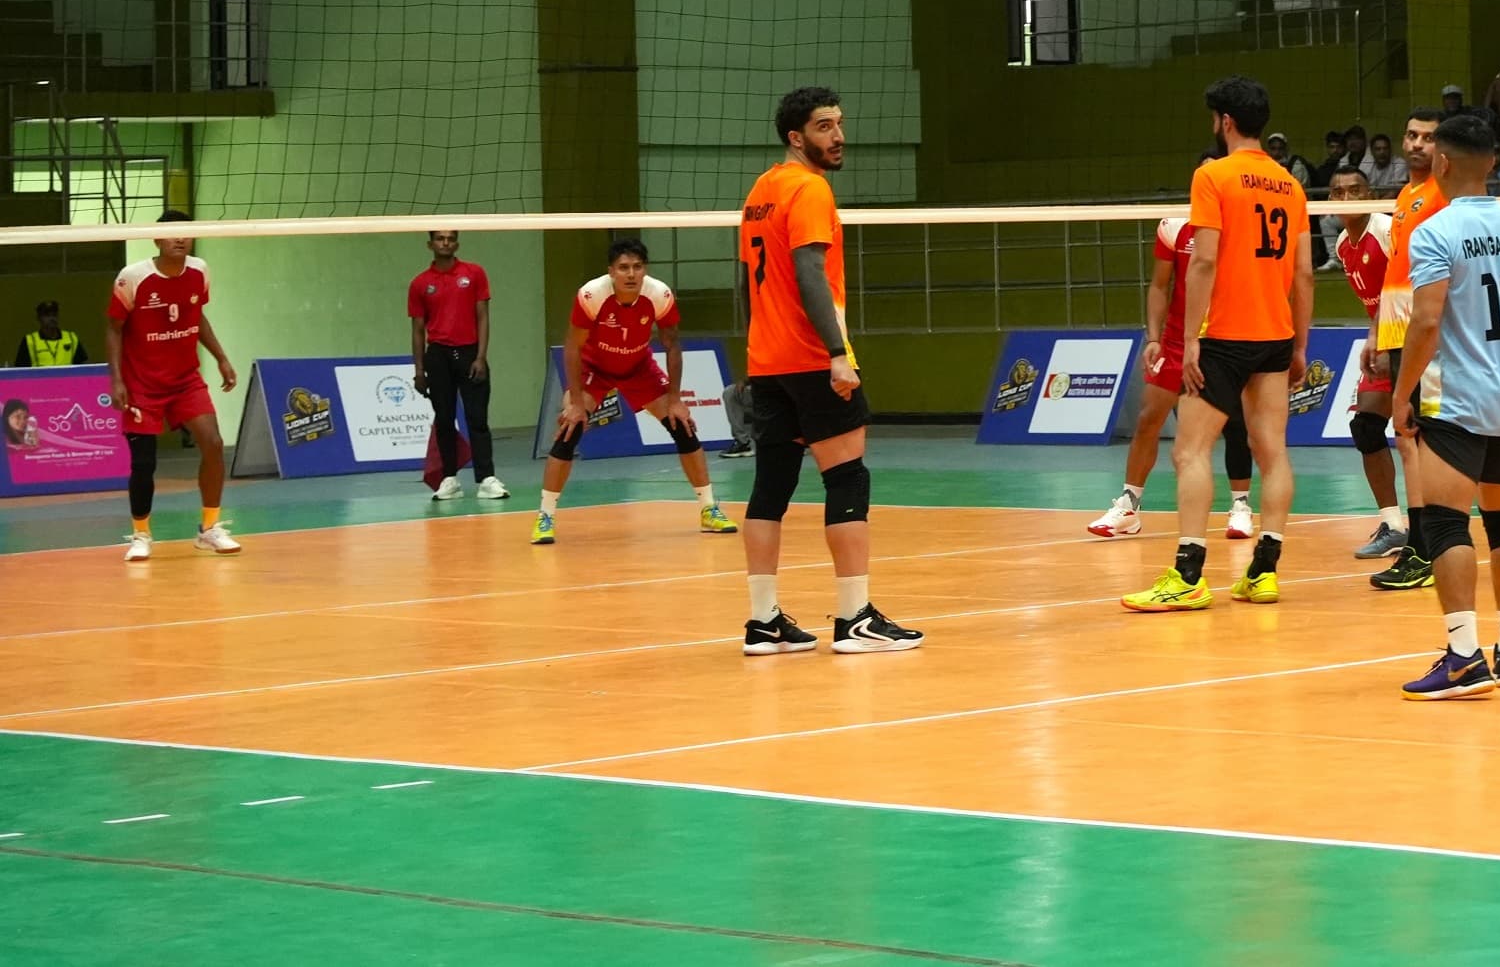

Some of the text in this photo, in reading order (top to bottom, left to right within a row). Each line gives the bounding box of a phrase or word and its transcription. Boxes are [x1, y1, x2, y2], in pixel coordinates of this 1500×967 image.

[1255, 203, 1288, 260] 13
[1352, 271, 1366, 290] 11
[169, 303, 179, 322] 9
